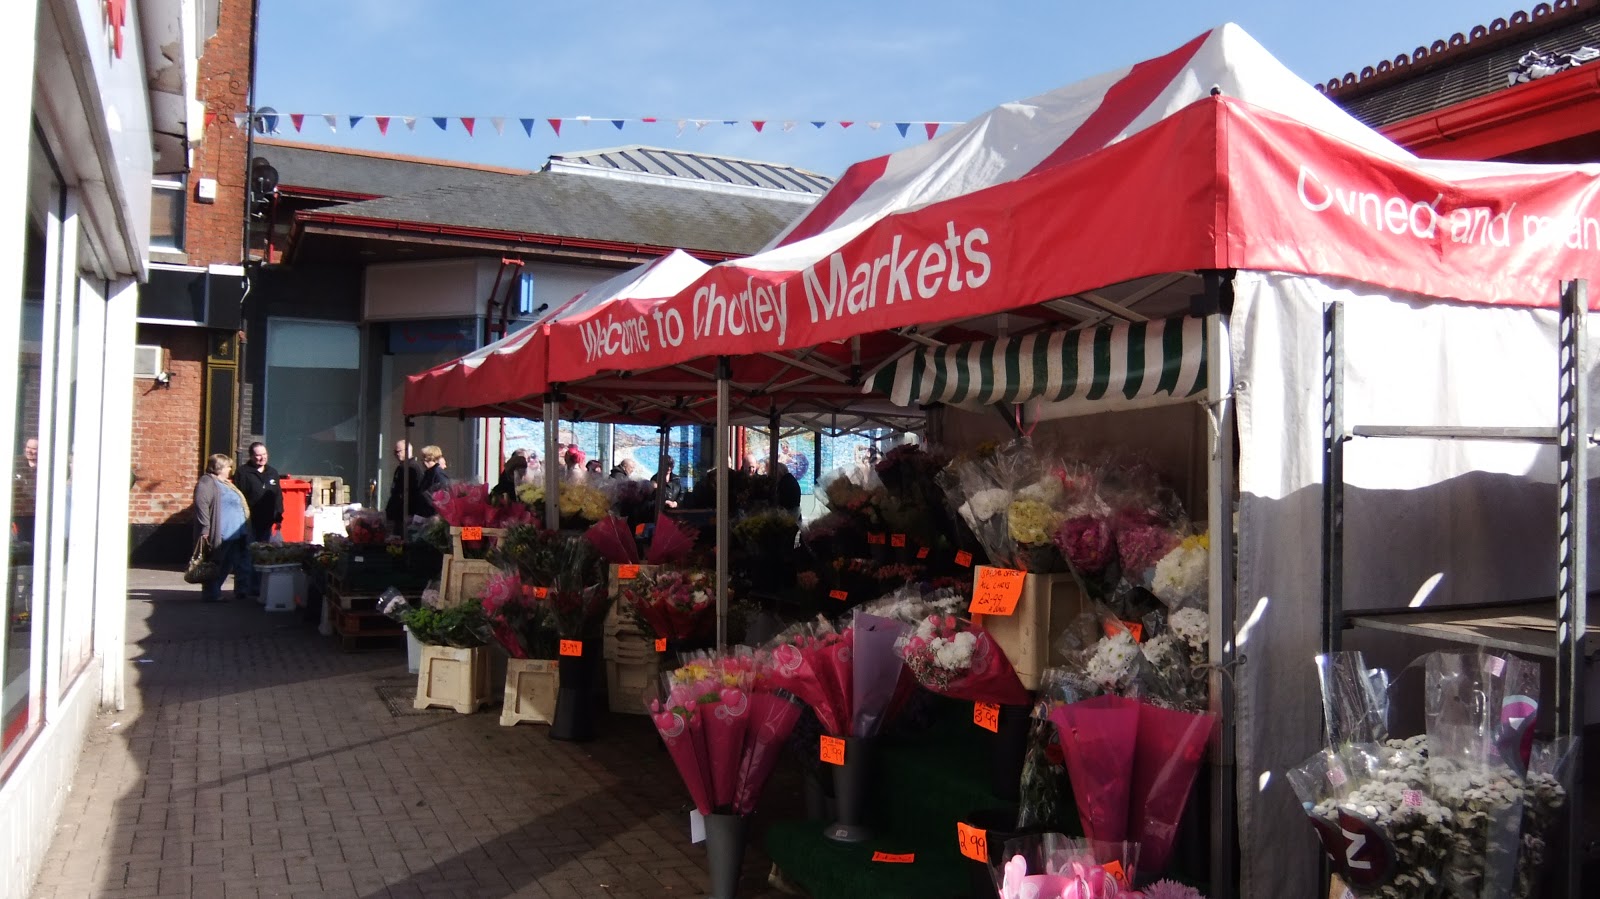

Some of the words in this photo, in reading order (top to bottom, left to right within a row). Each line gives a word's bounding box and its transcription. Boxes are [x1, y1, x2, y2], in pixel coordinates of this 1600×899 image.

[1449, 202, 1517, 247] and
[653, 307, 684, 348] to
[693, 275, 787, 346] Chorley
[803, 221, 991, 323] Markets
